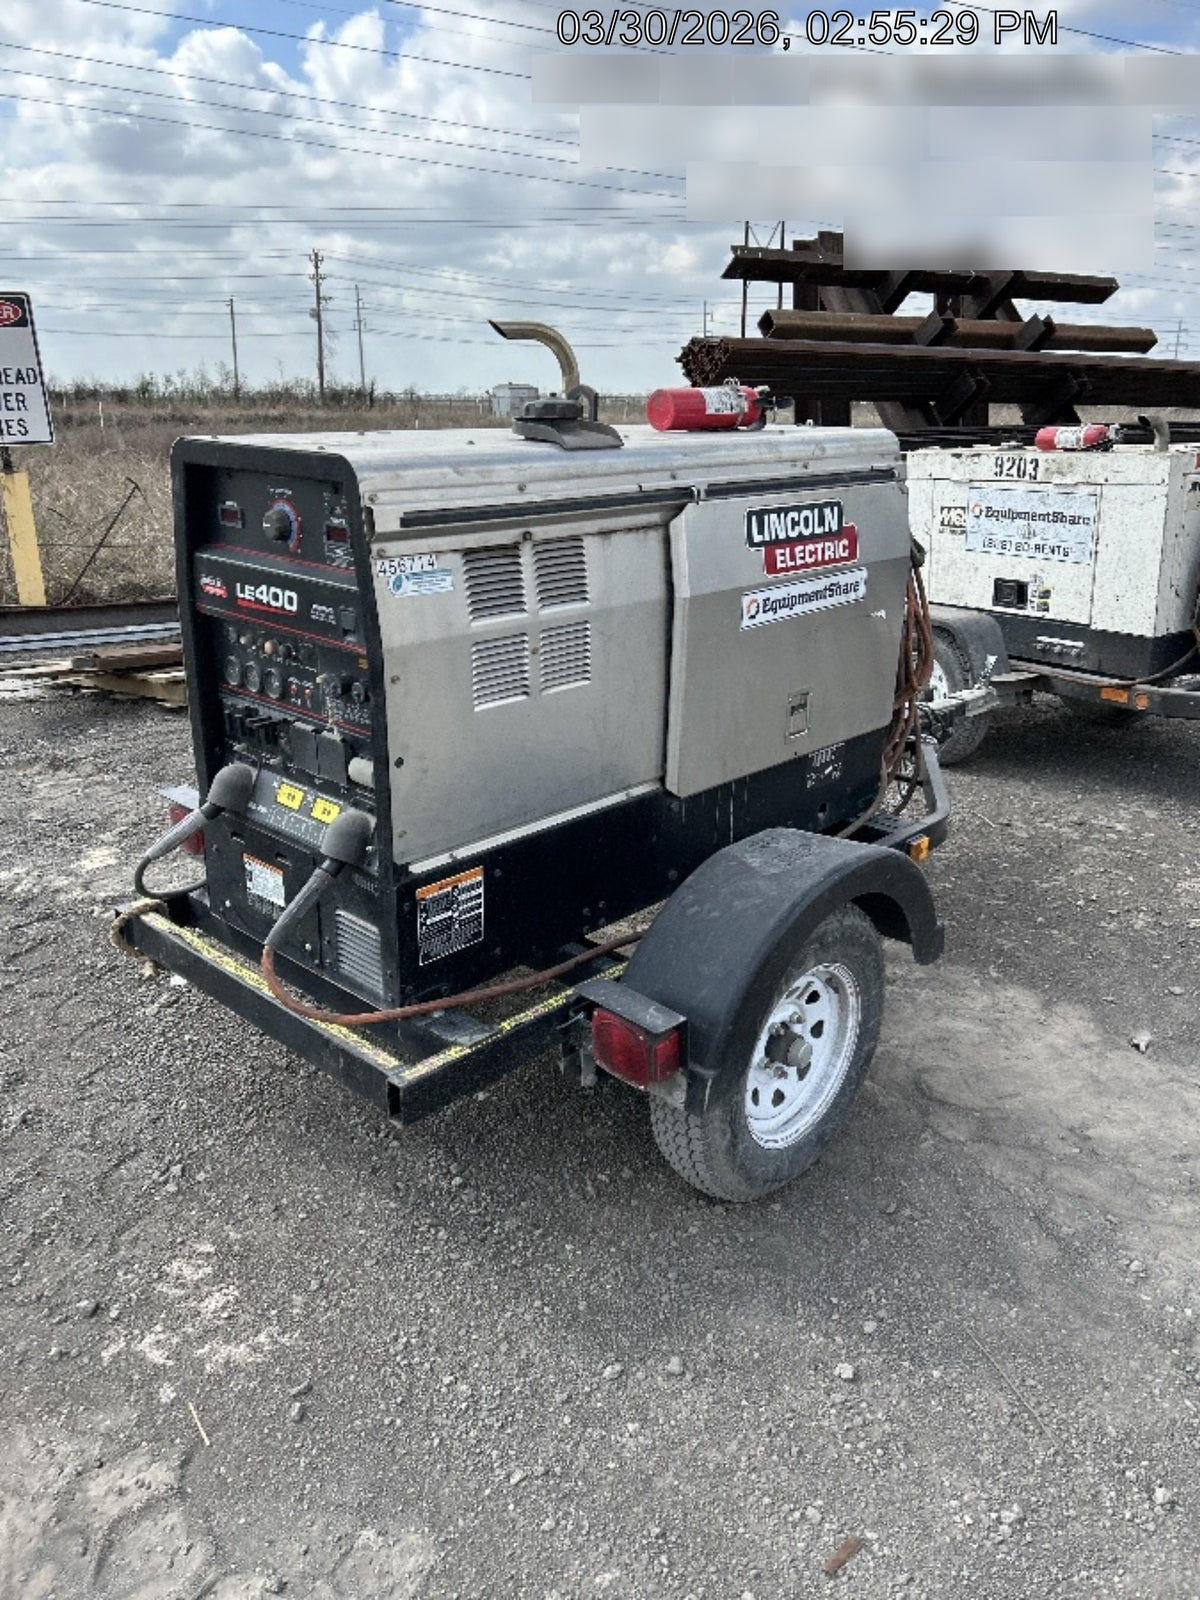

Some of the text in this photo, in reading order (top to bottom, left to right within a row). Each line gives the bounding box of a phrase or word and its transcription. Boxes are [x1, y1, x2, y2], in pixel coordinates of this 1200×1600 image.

[0, 367, 38, 385] EAD
[0, 392, 28, 411] ER
[994, 456, 1039, 480] 9203
[751, 506, 838, 543] LINCOLN
[984, 506, 1091, 526] EquipmentShare
[775, 538, 849, 569] ELECTRIC
[236, 582, 298, 612] LE400
[762, 581, 860, 615] EquipmentShare
